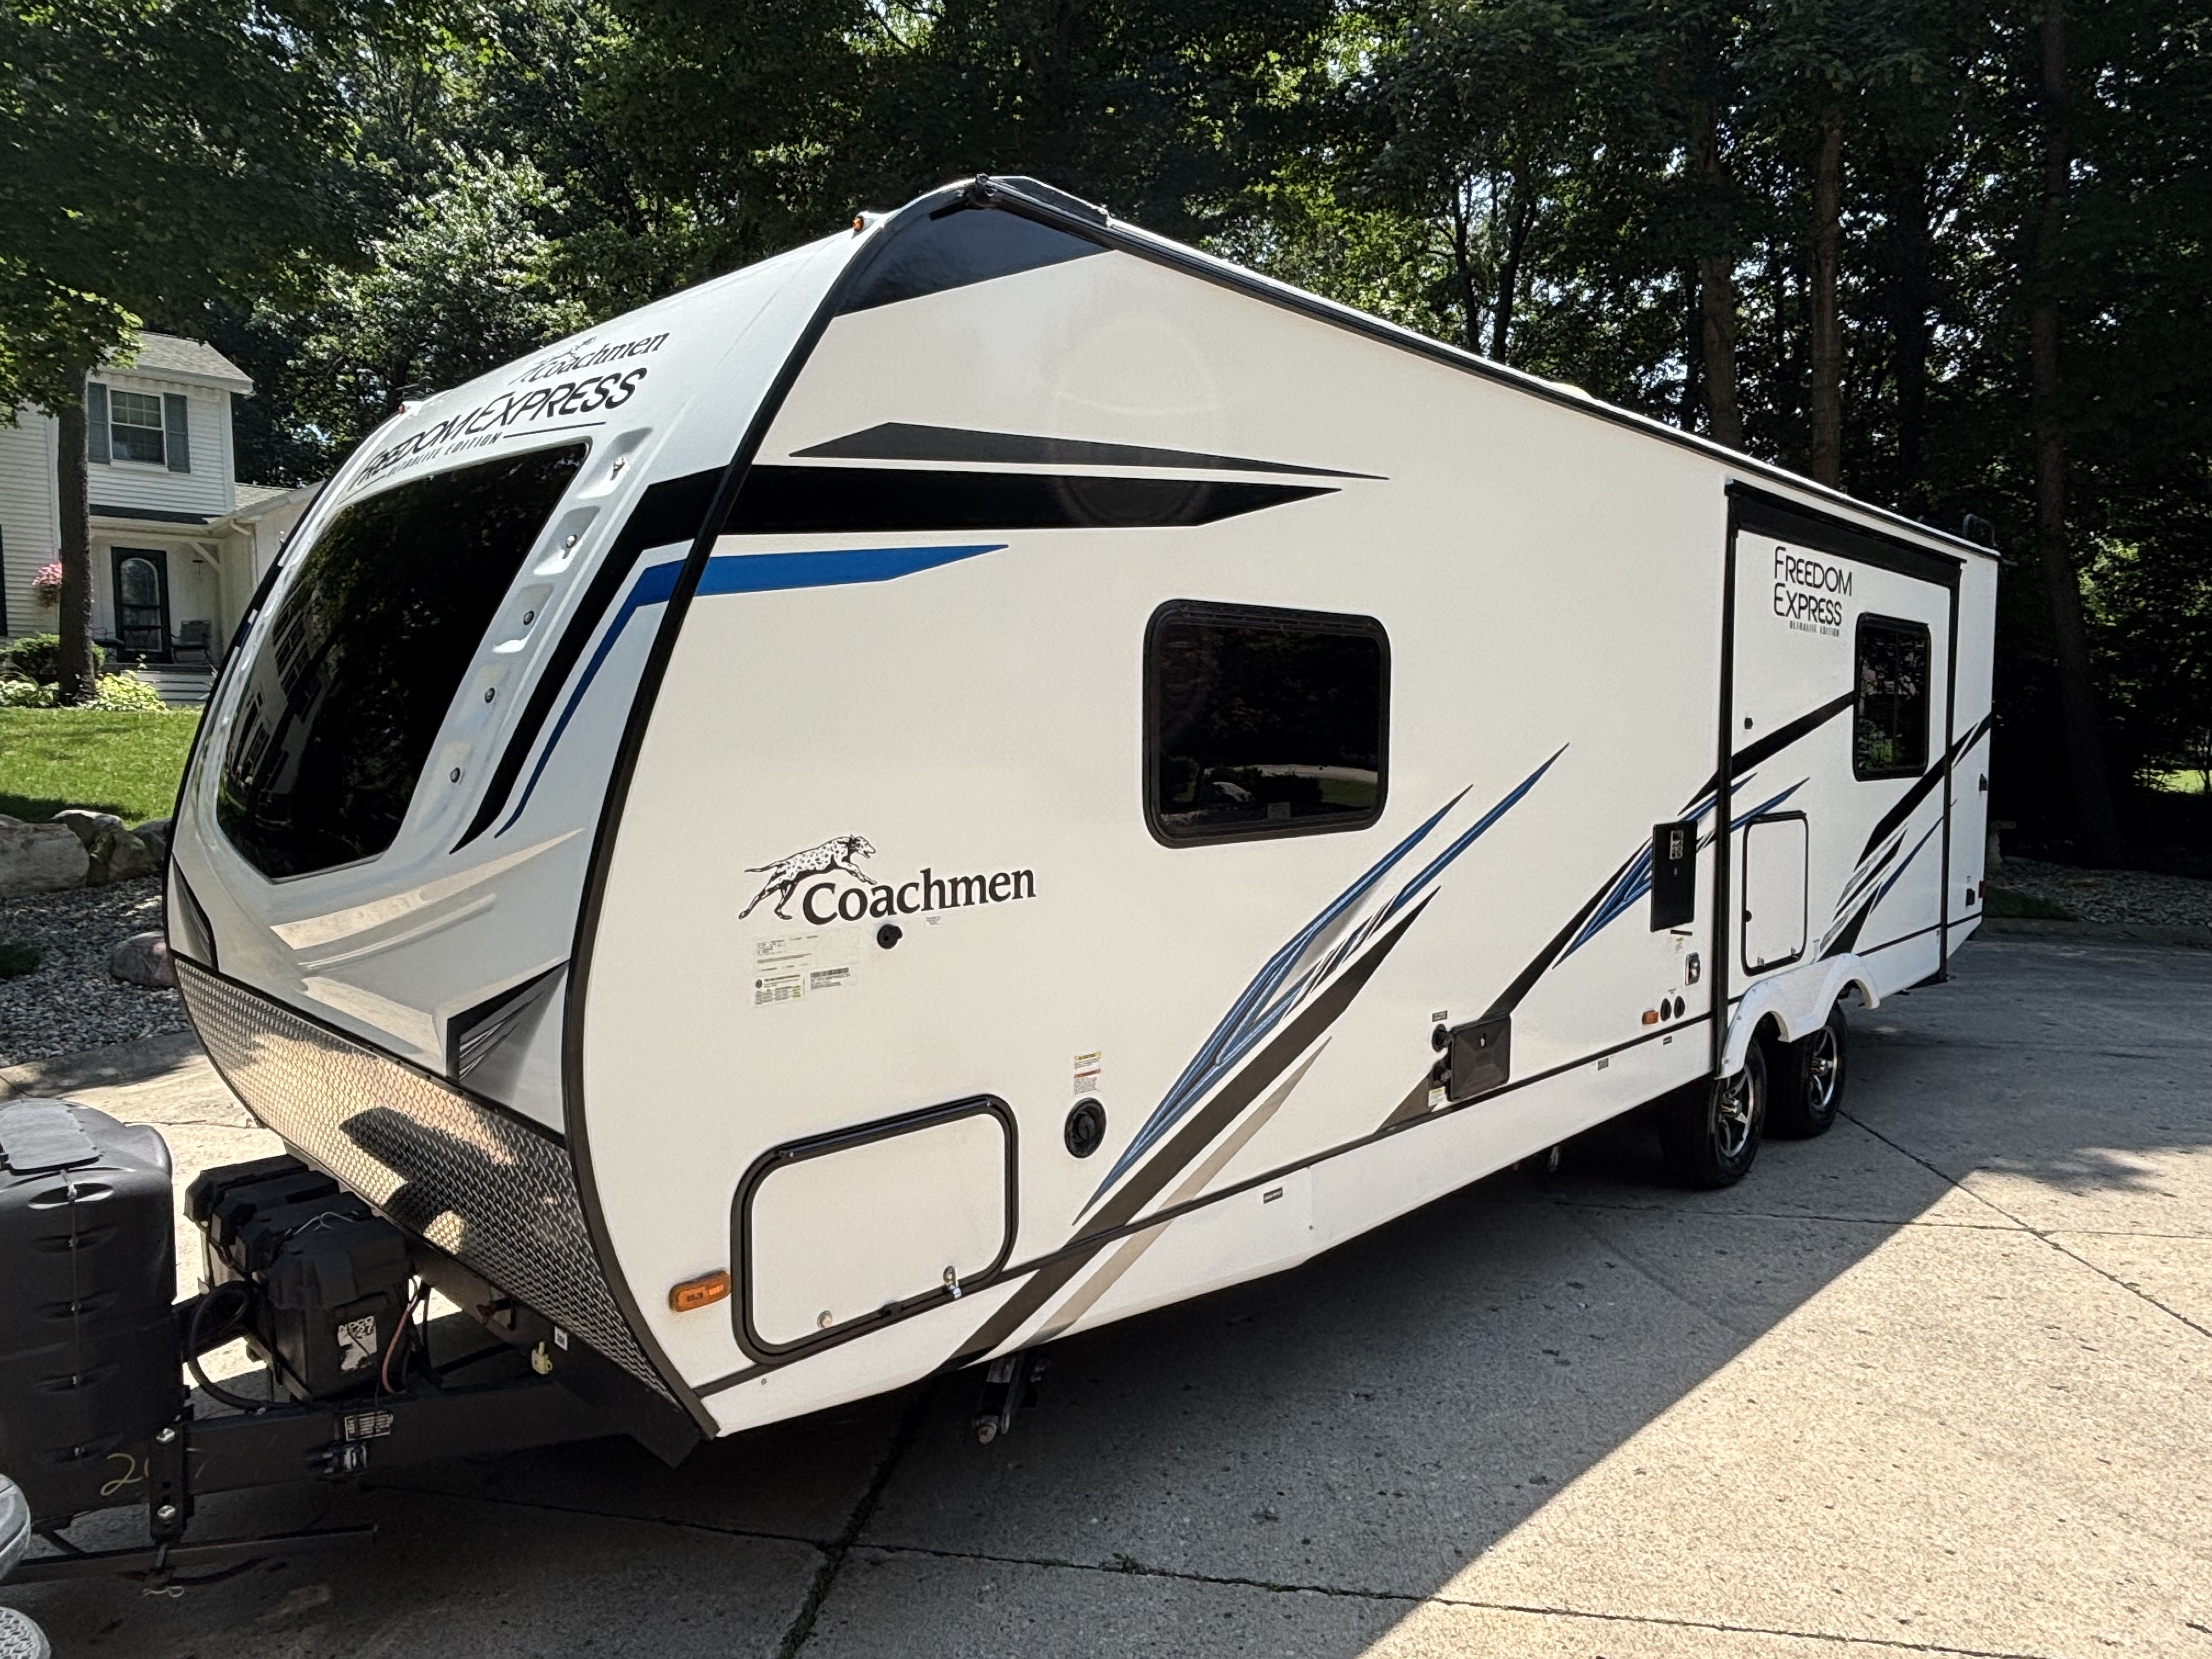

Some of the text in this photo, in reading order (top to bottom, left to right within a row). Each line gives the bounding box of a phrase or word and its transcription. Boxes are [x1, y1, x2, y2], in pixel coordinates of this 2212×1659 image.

[528, 333, 670, 382] Coachmen
[347, 368, 647, 492] FREEDOM EXPRESS
[444, 431, 503, 455] EDITION
[1774, 546, 1852, 597] FREEDOM
[1773, 583, 1842, 626] EXPRESS
[802, 867, 1036, 925] Coachmen
